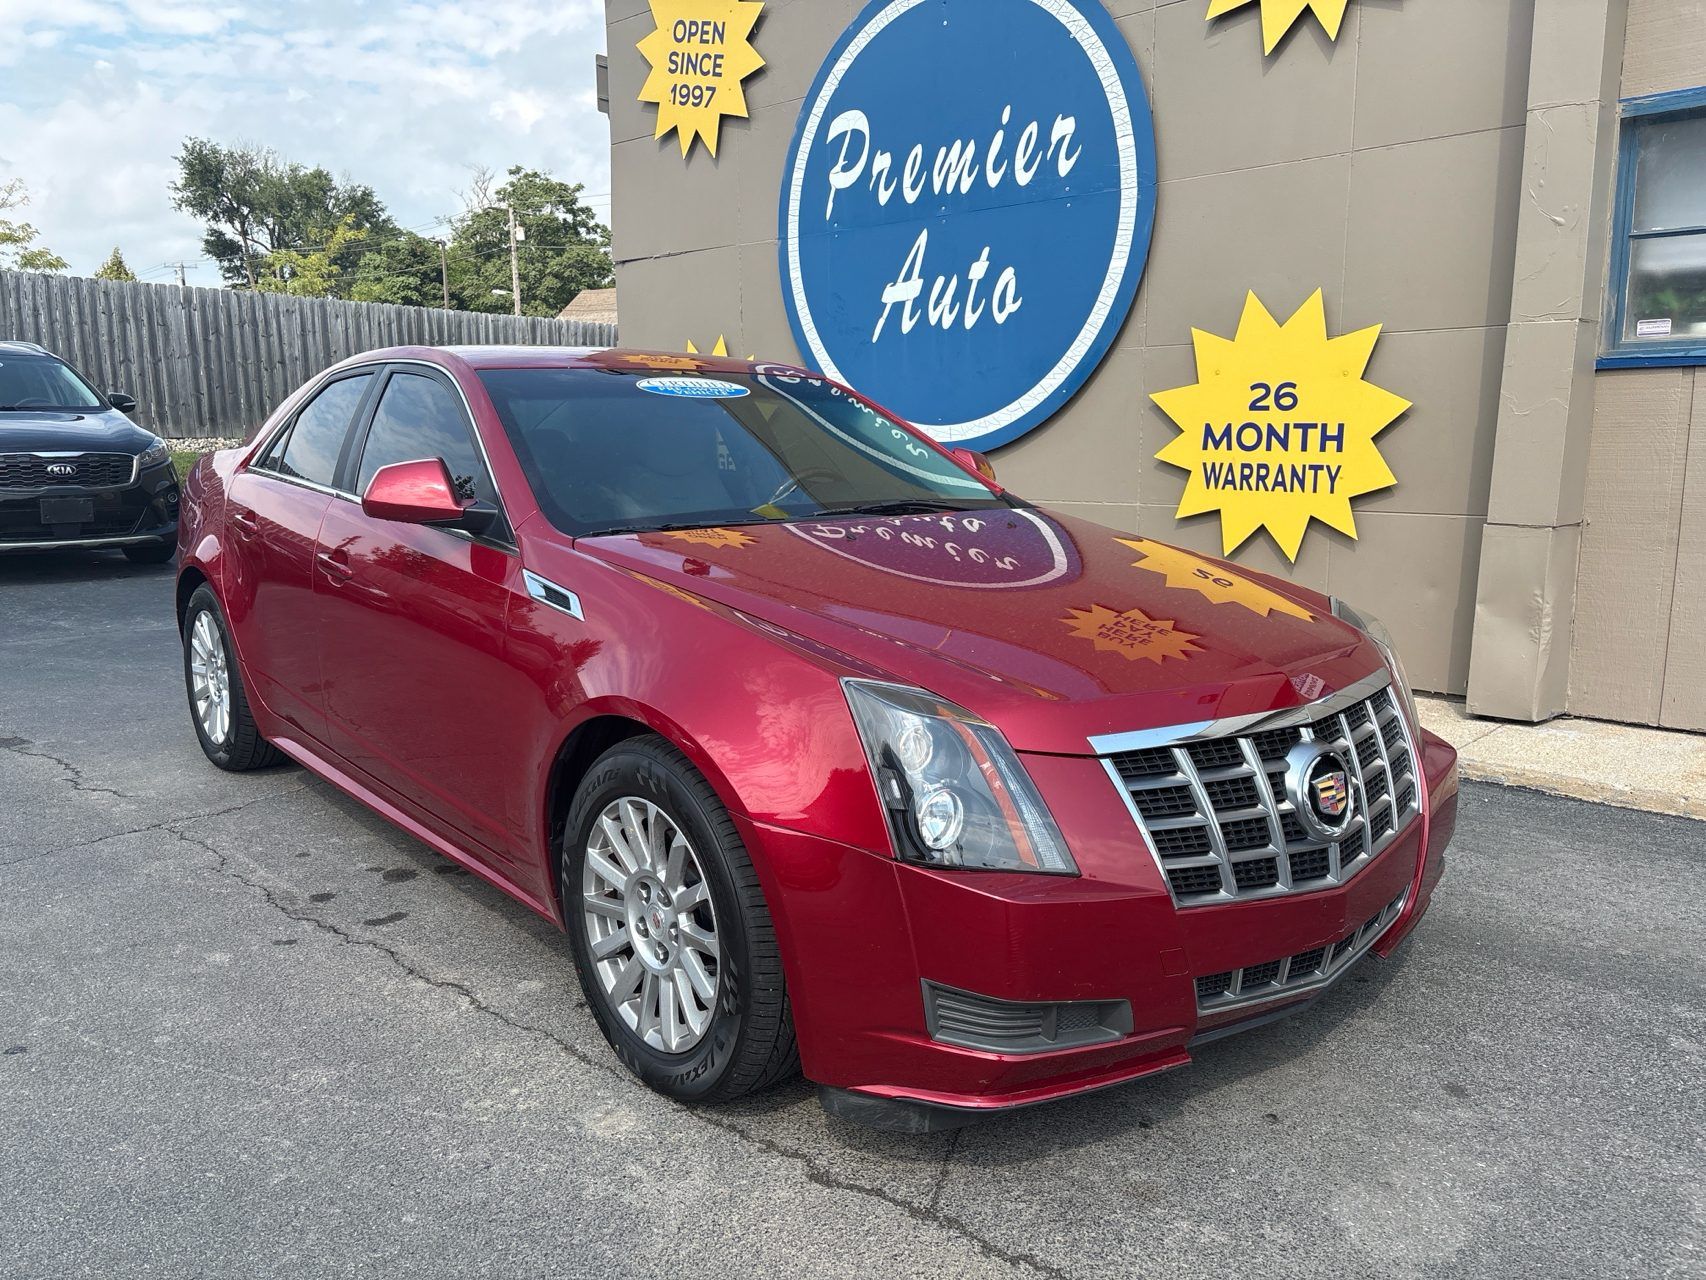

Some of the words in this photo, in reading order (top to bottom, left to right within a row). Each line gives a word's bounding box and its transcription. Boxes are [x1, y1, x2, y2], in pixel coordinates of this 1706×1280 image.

[672, 18, 726, 46] OPEN
[667, 51, 724, 78] SINCE
[669, 83, 717, 109] 1997
[826, 104, 1082, 221] Premier
[872, 228, 1023, 344] Auto
[1248, 382, 1298, 411] 26
[1202, 423, 1345, 452] MONTH
[53, 466, 73, 475] KIA
[1202, 462, 1342, 494] WARRANTY
